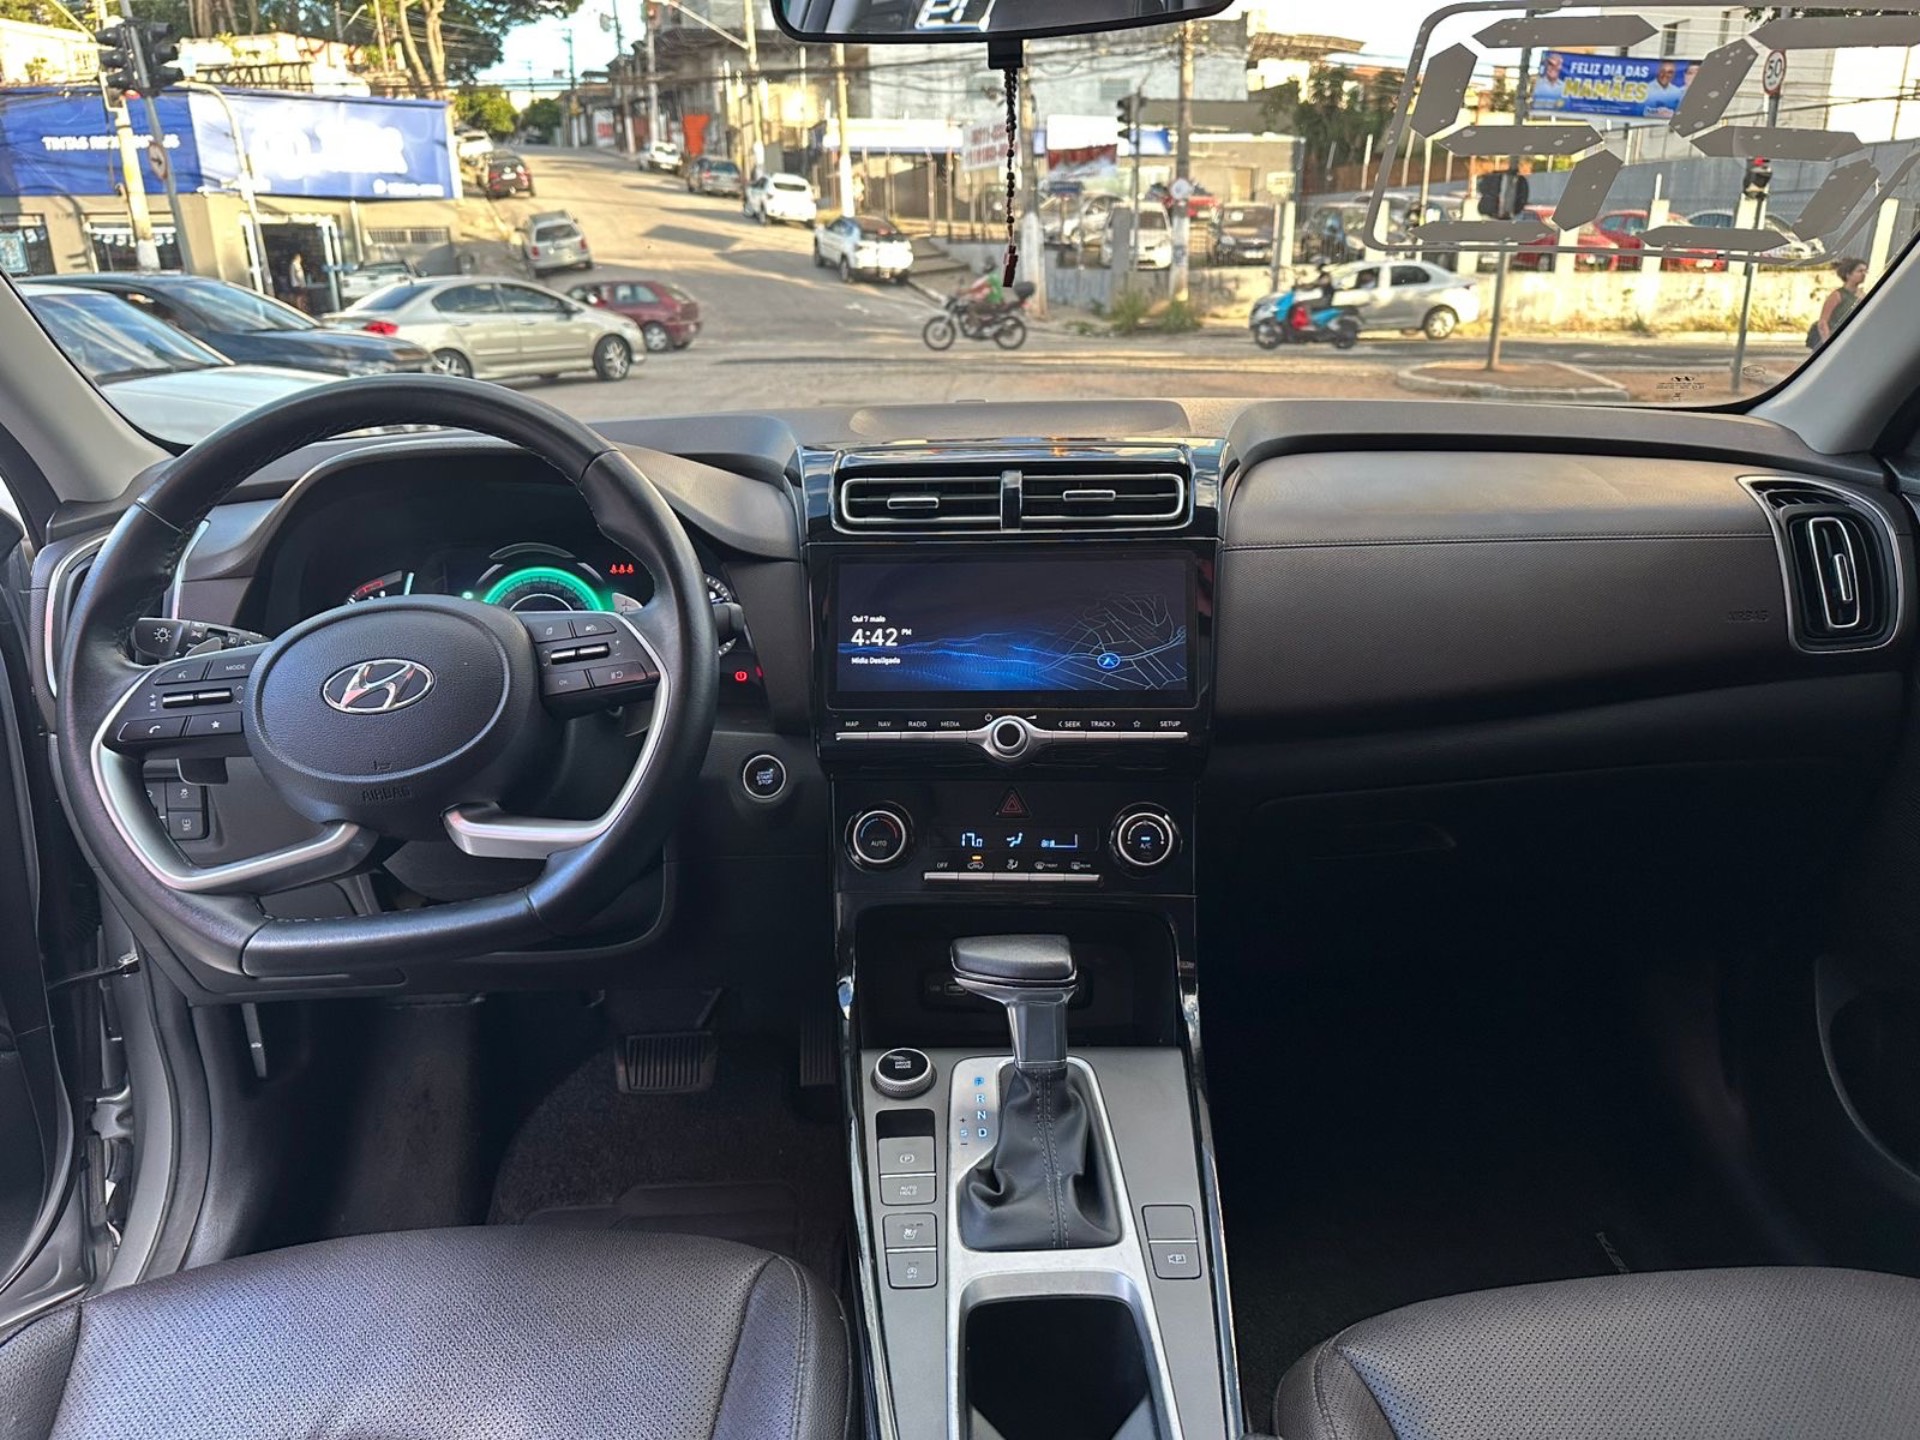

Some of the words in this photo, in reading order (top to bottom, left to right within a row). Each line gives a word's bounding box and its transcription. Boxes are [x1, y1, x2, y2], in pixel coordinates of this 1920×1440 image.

[1570, 62, 1600, 76] FELIZ
[1602, 64, 1622, 77] DIA
[1625, 65, 1650, 78] DAS
[1767, 58, 1783, 79] 50
[1562, 76, 1650, 103] MAMÃES
[851, 627, 898, 646] 4:42
[845, 720, 860, 728] MAP
[877, 720, 892, 728] NAV
[907, 720, 928, 728] RADIO
[940, 720, 961, 728] MEDIA
[1159, 720, 1181, 728] SETUP
[976, 1094, 985, 1103] R
[977, 1110, 986, 1120] N
[978, 1127, 988, 1137] D
